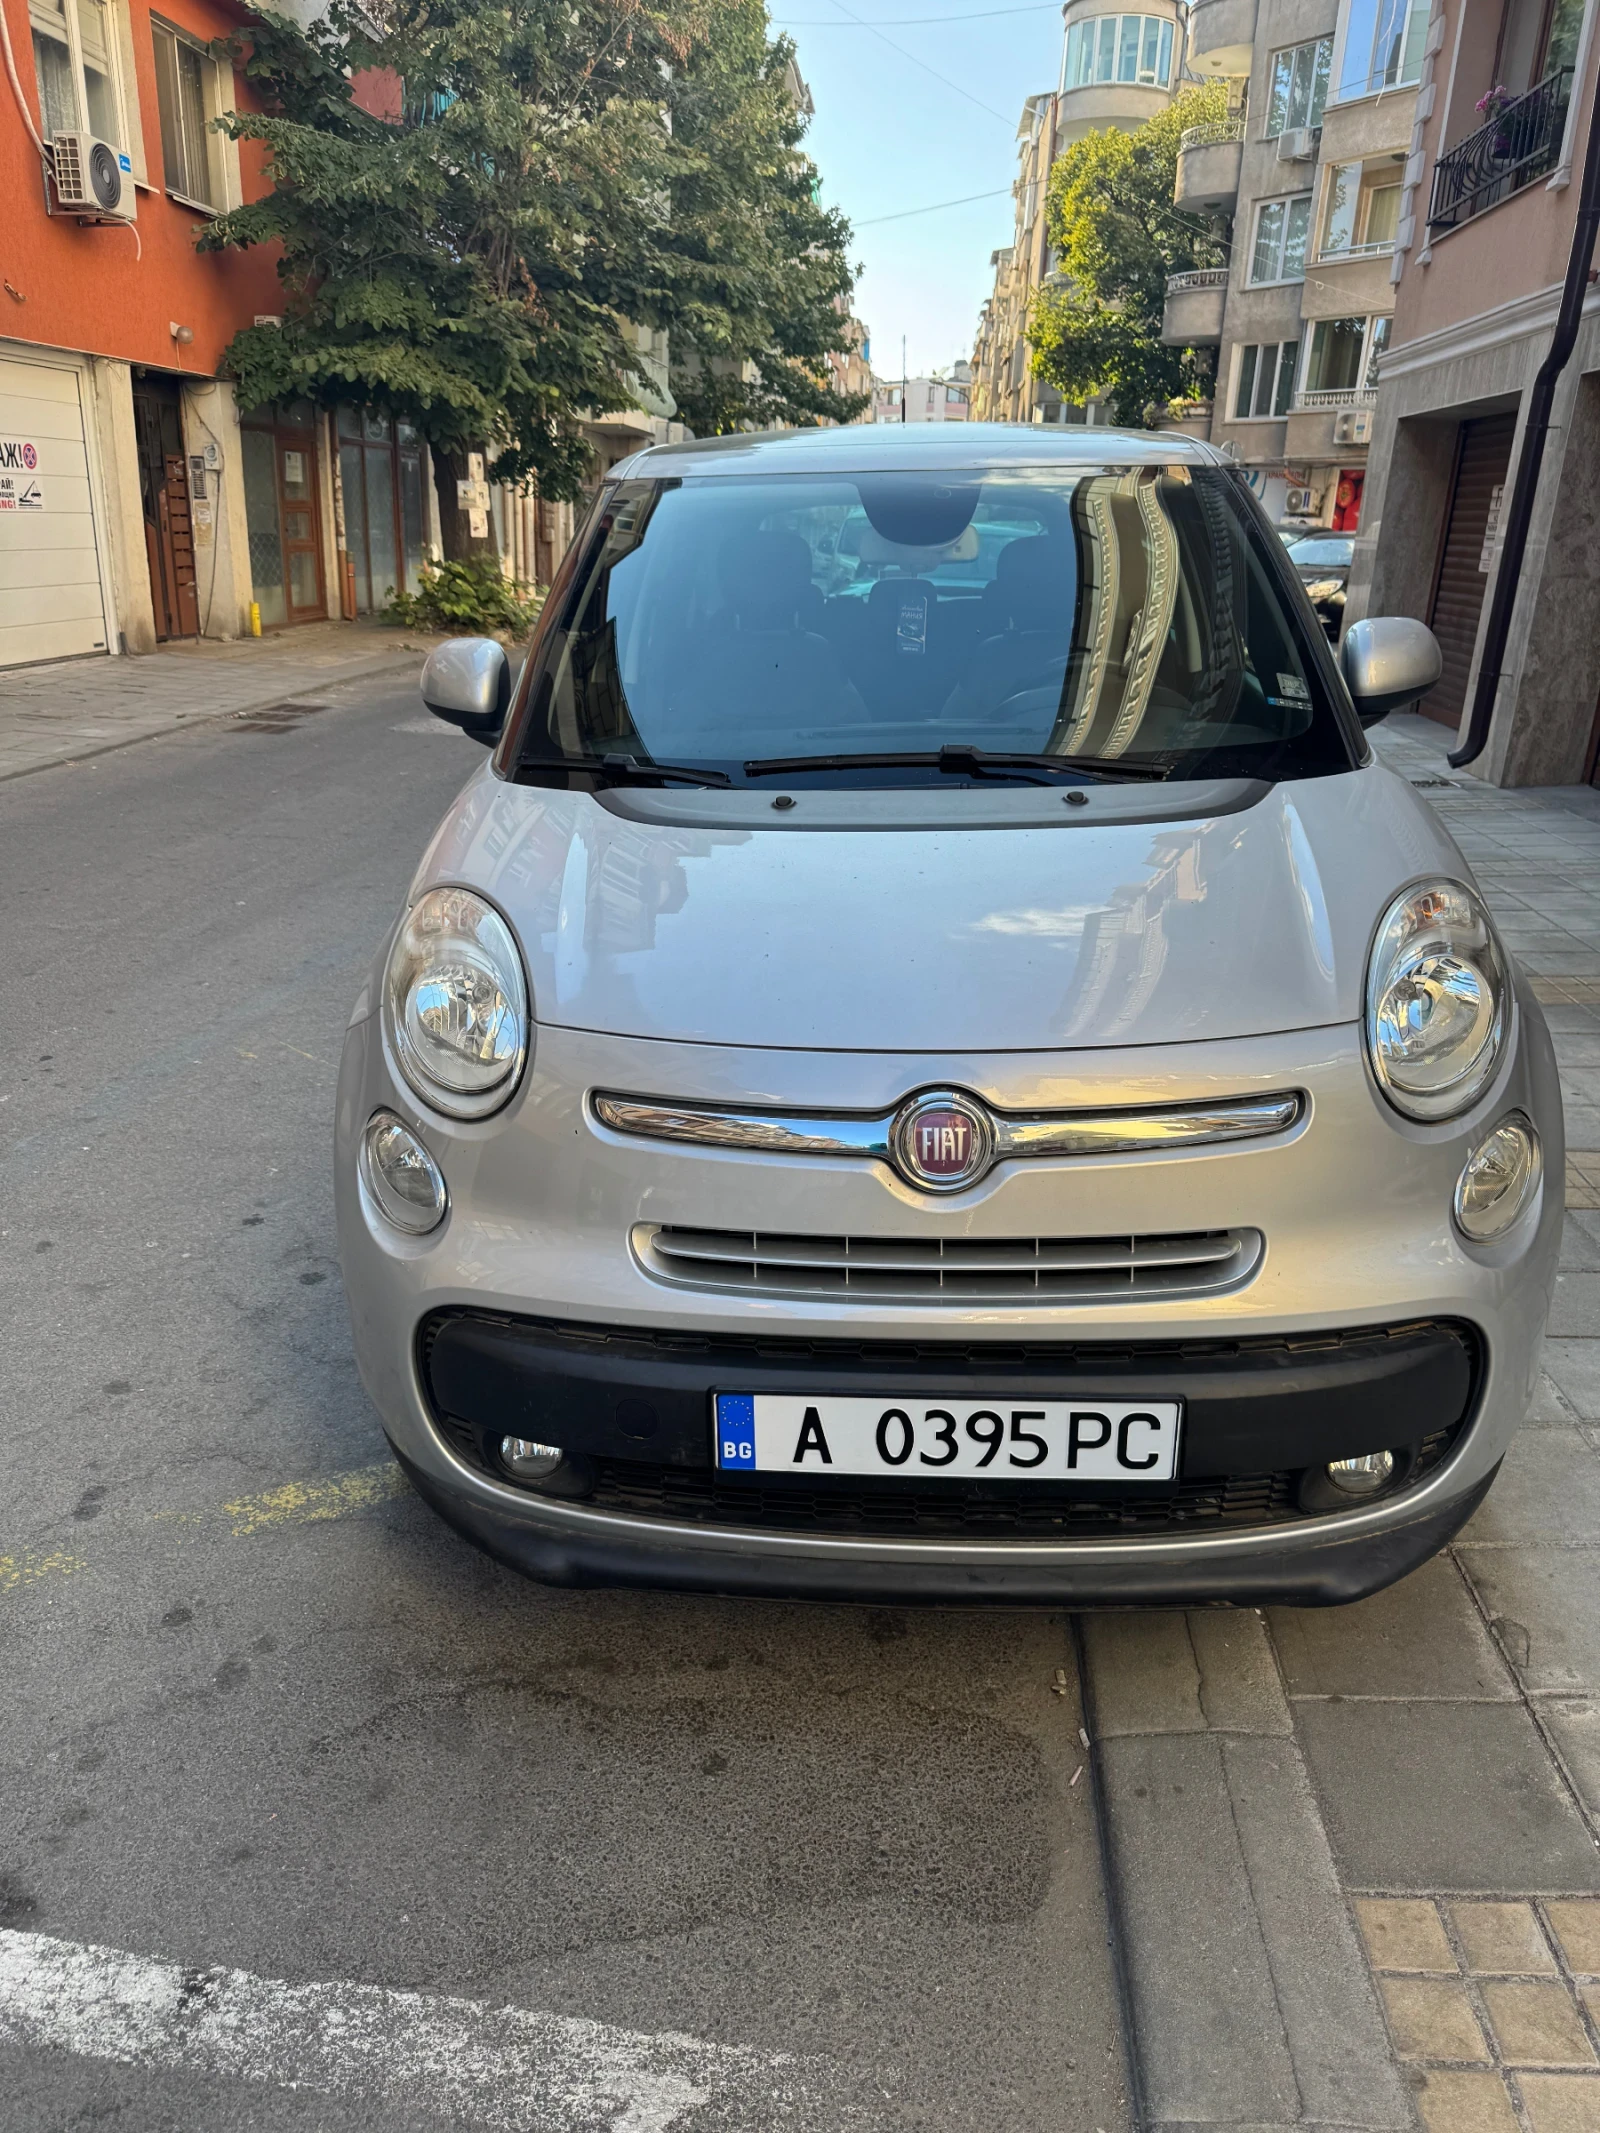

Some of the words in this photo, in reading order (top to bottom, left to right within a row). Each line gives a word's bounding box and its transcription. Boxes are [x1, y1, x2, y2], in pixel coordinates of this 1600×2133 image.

[0, 478, 14, 490] АЙ!
[922, 1127, 967, 1161] FIAT
[723, 1441, 752, 1459] BG
[793, 1406, 833, 1464] A
[876, 1408, 1049, 1468] 0395
[1067, 1411, 1161, 1470] PC
